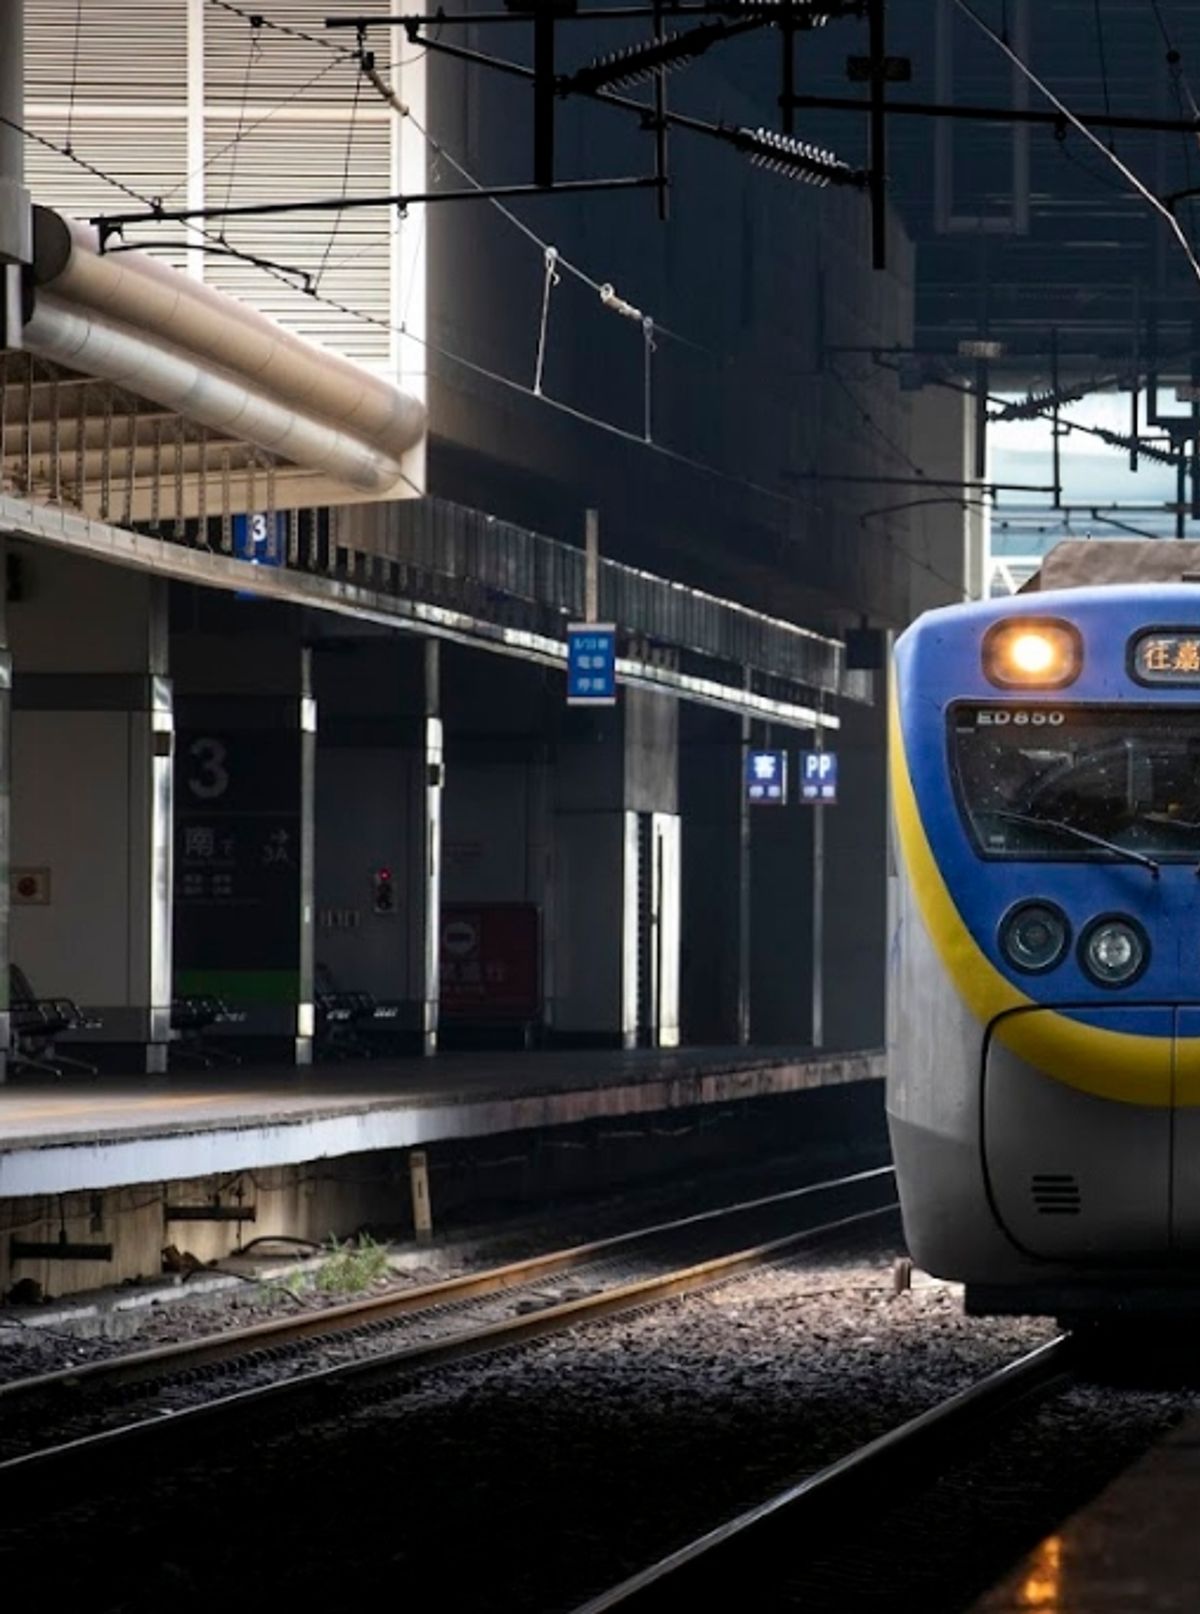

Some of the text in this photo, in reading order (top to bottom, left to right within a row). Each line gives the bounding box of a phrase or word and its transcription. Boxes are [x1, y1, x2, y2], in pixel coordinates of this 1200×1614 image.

[252, 513, 266, 542] 3
[188, 737, 229, 799] 3
[806, 754, 832, 779] PP
